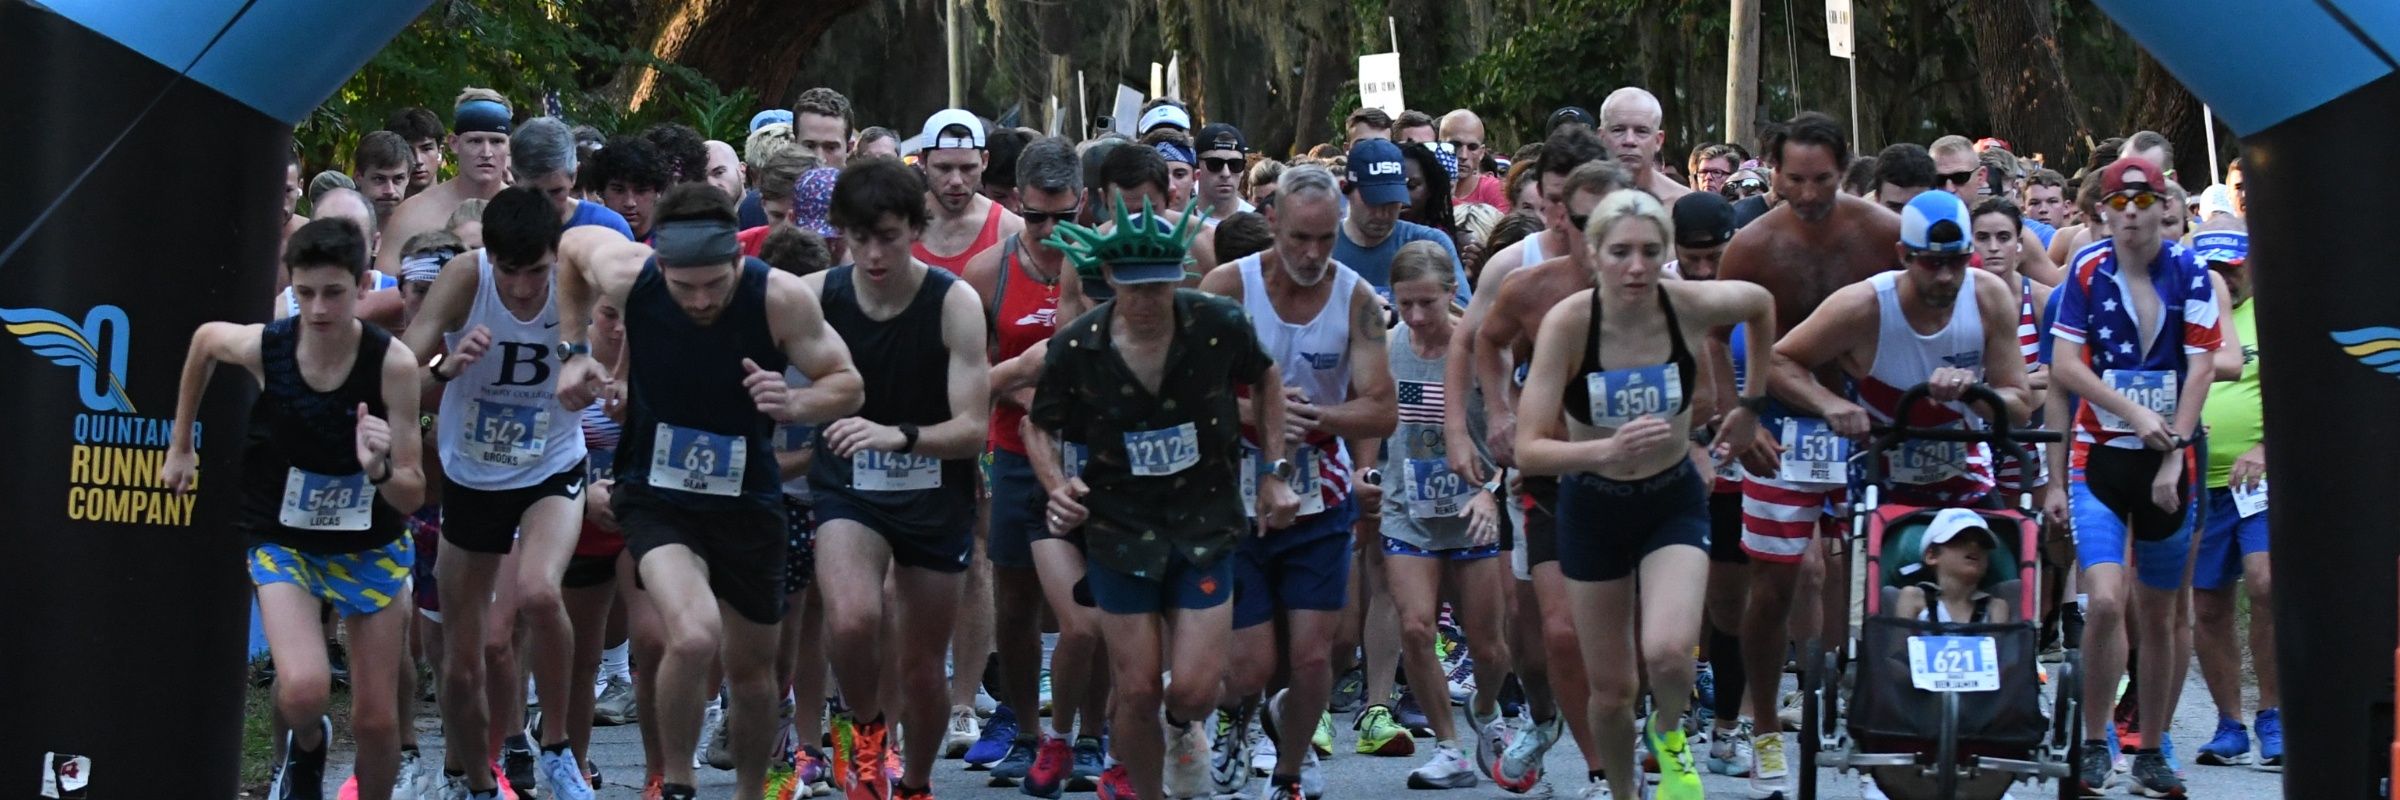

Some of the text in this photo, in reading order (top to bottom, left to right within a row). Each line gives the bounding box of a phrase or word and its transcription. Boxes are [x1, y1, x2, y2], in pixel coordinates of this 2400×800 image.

[1369, 161, 1402, 175] USA
[490, 341, 551, 387] B
[1614, 386, 1660, 416] 350
[74, 413, 203, 449] QUINTANR
[482, 417, 527, 448] 542
[483, 451, 518, 466] BROOKS
[684, 446, 716, 475] 63
[874, 451, 928, 469] 1432
[1126, 436, 1186, 466] 1212
[1801, 434, 1840, 461] 531
[683, 478, 708, 490] SEAN
[1424, 473, 1460, 499] 629
[1810, 469, 1830, 480] PETE
[68, 486, 197, 526] COMPANY
[306, 487, 353, 511] 548
[310, 516, 341, 527] LUCAS
[1933, 649, 1975, 672] 621
